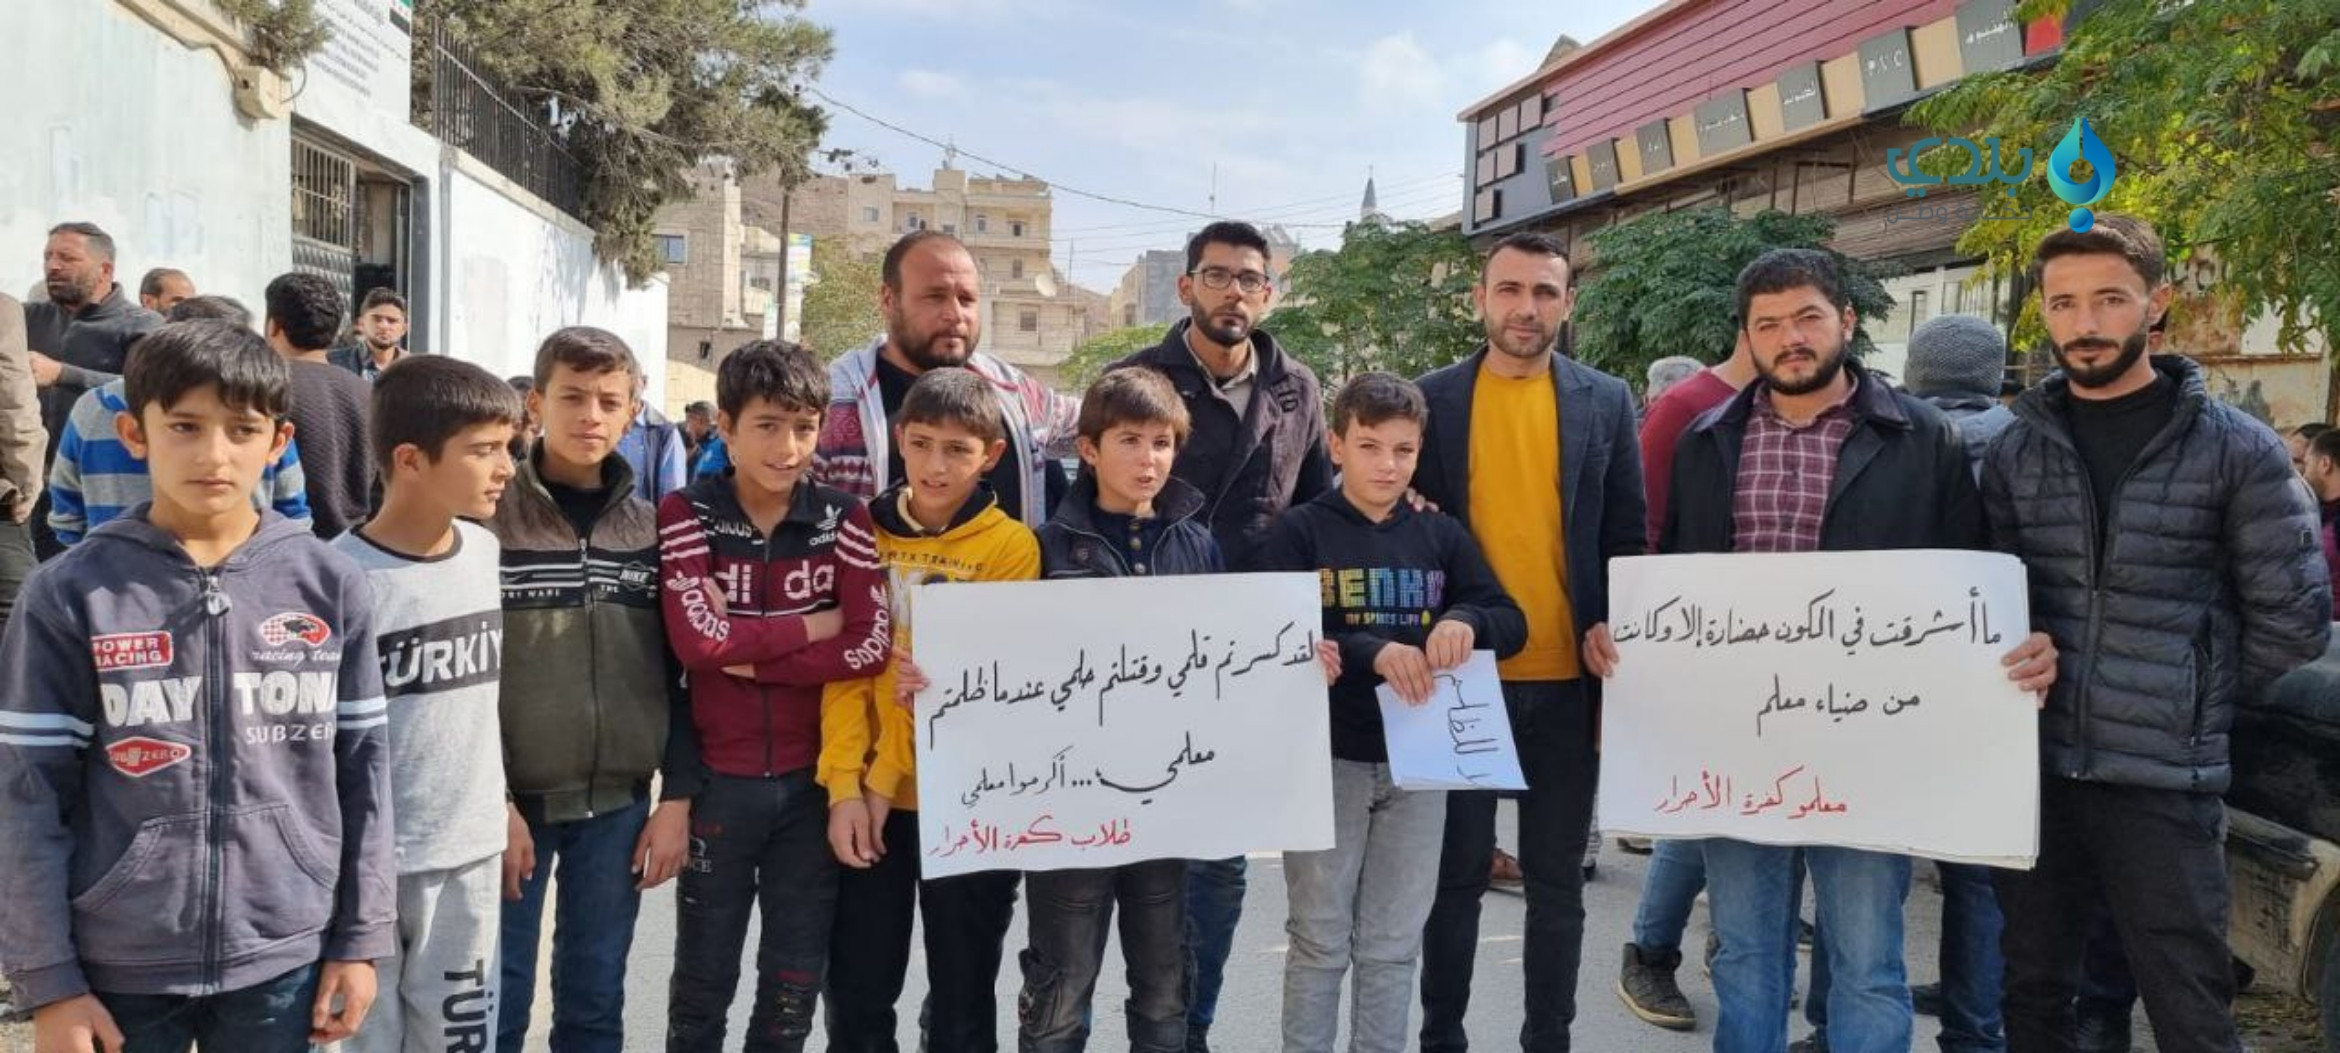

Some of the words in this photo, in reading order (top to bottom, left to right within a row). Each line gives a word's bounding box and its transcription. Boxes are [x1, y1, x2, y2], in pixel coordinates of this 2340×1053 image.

[1674, 604, 1702, 648] إلا
[1705, 608, 1770, 647] حضارة
[1774, 588, 1835, 643] الكون
[1841, 606, 1864, 656] في
[1869, 586, 1980, 647] أشرقت
[1982, 601, 2002, 644] ما
[1167, 629, 1211, 698] قلمي
[1215, 621, 1295, 701] كسرتم
[1282, 629, 1315, 667] لقد
[100, 675, 202, 728] DAY
[993, 660, 1045, 705] عندما
[1050, 649, 1095, 712] حلمي
[1099, 643, 1163, 728] وقتلتم
[1815, 683, 1869, 723] ضياء
[929, 666, 989, 752] ظلمتم
[1756, 672, 1806, 739] معلم
[1882, 693, 1921, 716] من
[960, 768, 1005, 809] معلمي
[1008, 745, 1074, 797] أكرموا
[1653, 770, 1731, 814] الأحرار
[1786, 776, 1847, 820] معلمو
[929, 819, 998, 858] الأحرار
[1070, 818, 1131, 851] طلاب
